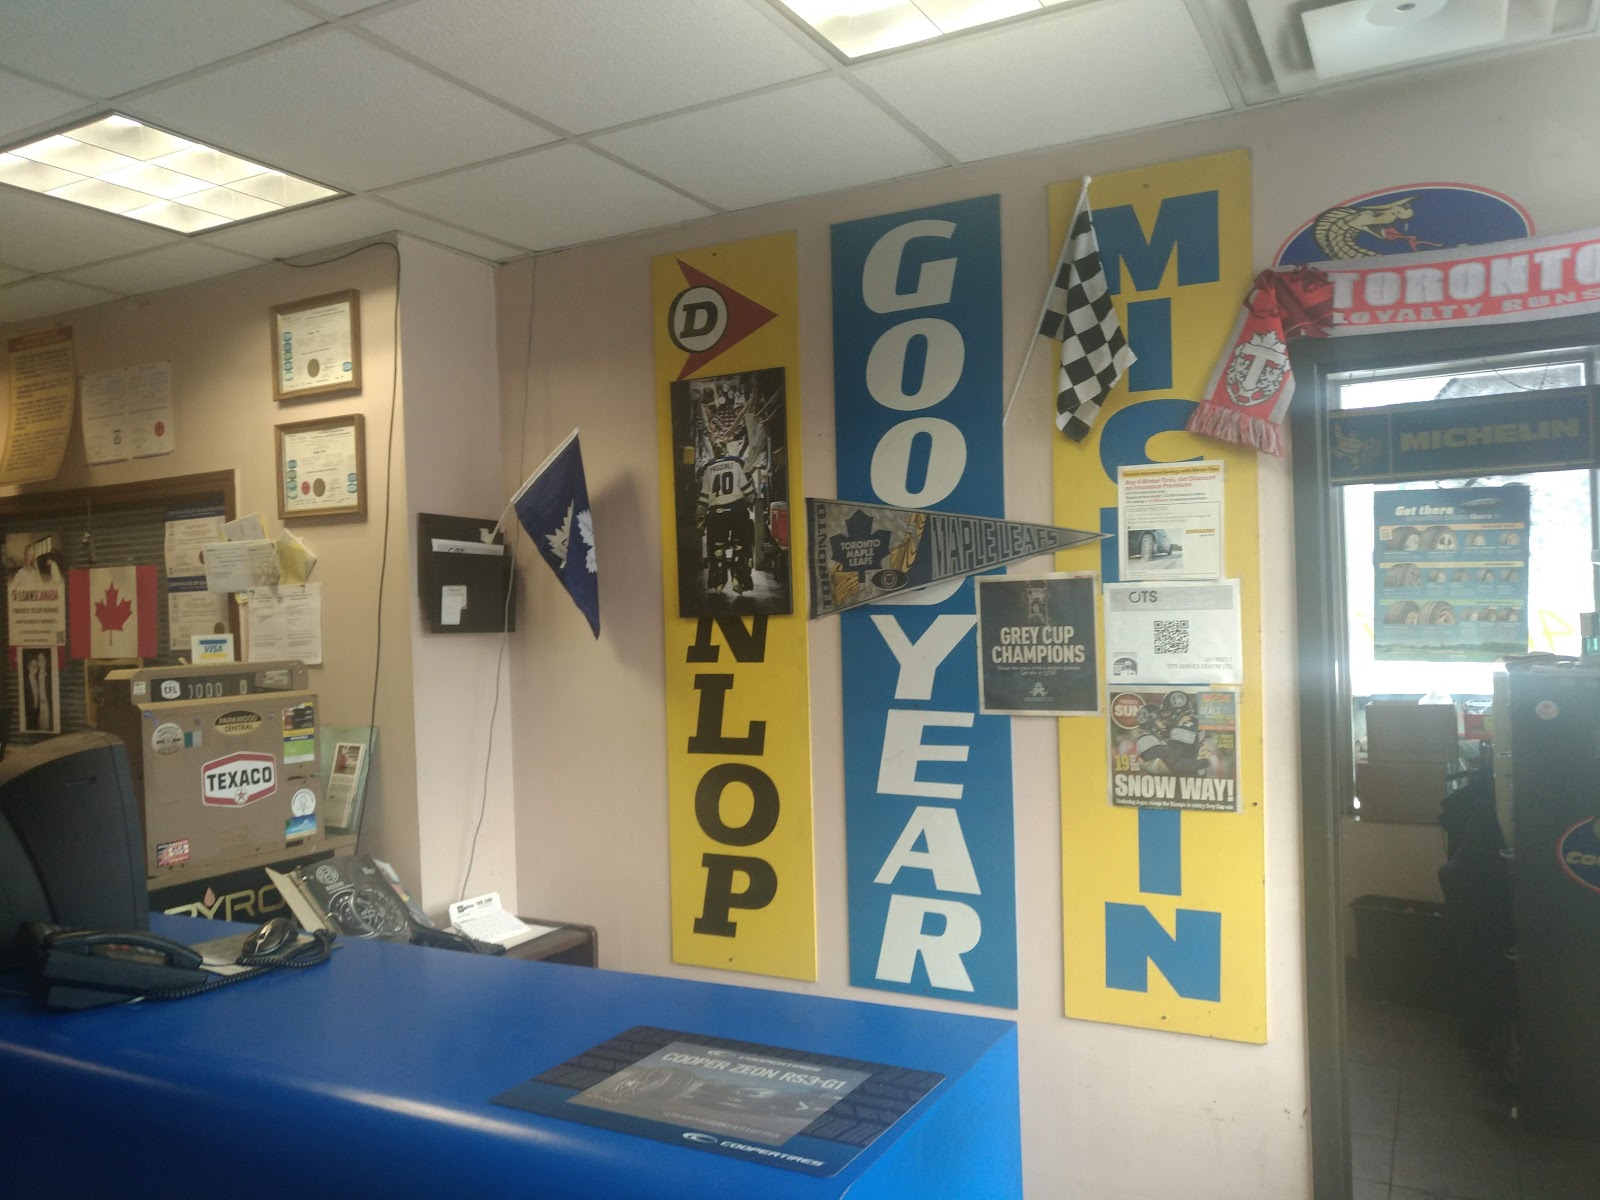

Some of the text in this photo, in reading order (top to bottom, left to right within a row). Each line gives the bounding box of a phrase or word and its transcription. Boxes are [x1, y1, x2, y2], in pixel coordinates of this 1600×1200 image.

[1328, 242, 1600, 310] TORONTO
[1333, 288, 1600, 324] LOYALTY RUNS
[679, 301, 719, 339] D
[1399, 418, 1582, 452] MICHELIN
[712, 471, 734, 497] 40
[1394, 504, 1456, 516] Get there
[839, 539, 882, 550] TORONTO
[846, 549, 875, 558] MAPLE
[930, 514, 1058, 579] MAPLE LEAFS
[814, 503, 832, 608] TORONTO
[849, 556, 873, 567] LEAFS
[1128, 590, 1158, 603] OTS
[1000, 625, 1074, 645] GREY CUP
[203, 644, 224, 655] VISA
[991, 644, 1085, 664] CHAMPIONS
[163, 684, 178, 695] CFL
[218, 714, 259, 724] PARKWOOD
[223, 722, 254, 732] CENTRAL
[1114, 754, 1131, 772] 19
[206, 766, 273, 792] TEXACO
[1114, 773, 1235, 802] SNOW WAY!
[662, 1051, 847, 1090] COOPER ZEON RS3-G1
[719, 1140, 825, 1168] COOPERTIRES
